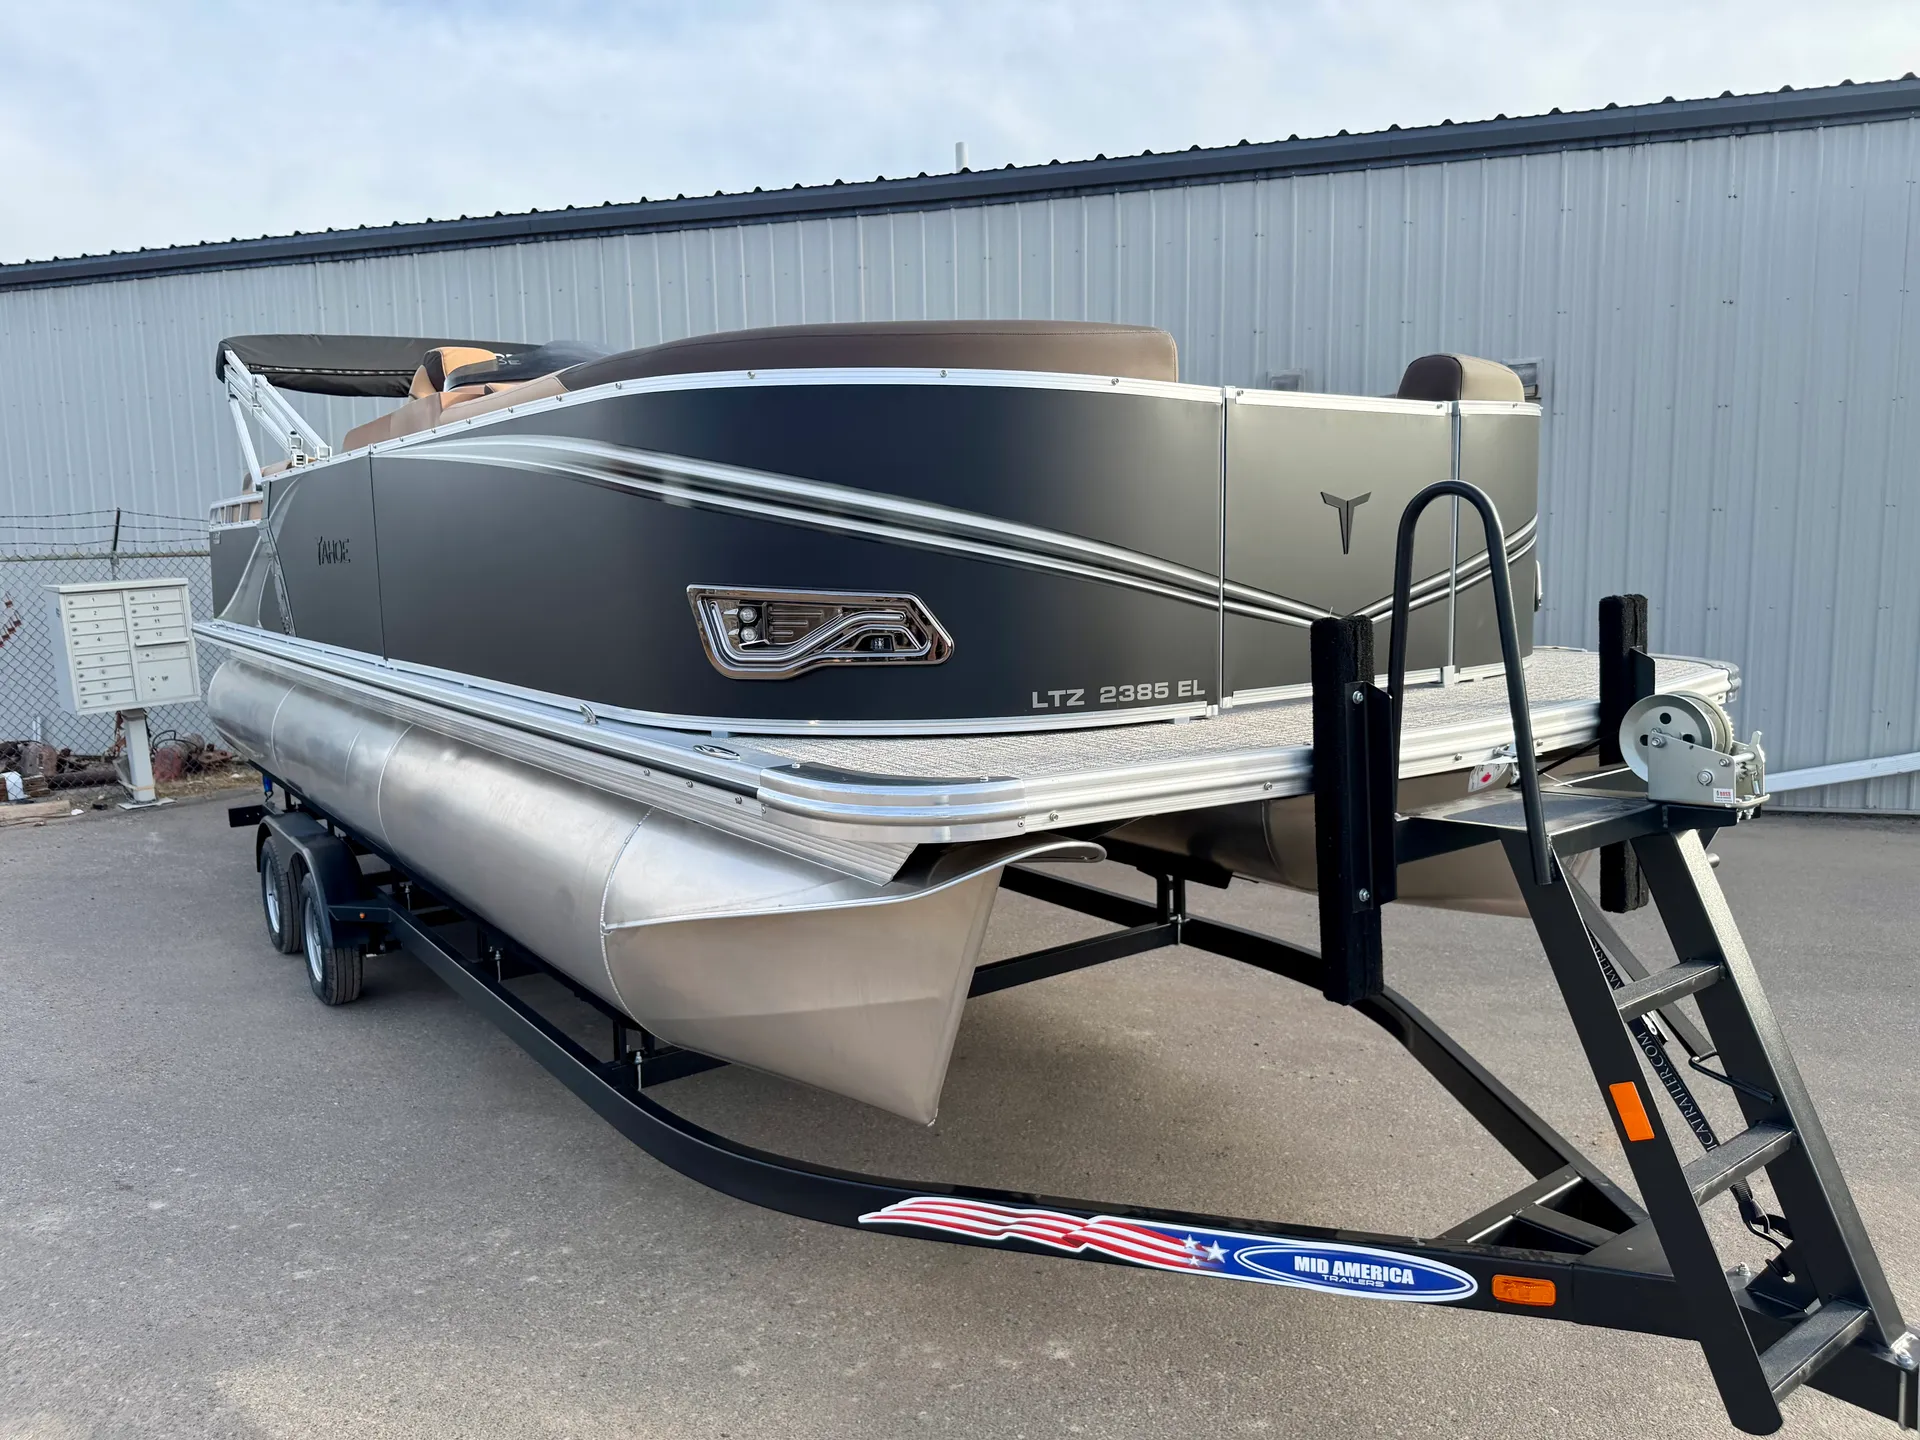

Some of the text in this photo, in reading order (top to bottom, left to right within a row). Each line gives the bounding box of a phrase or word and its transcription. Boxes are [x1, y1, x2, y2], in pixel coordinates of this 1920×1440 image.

[316, 535, 351, 566] TAHOE
[1032, 679, 1206, 708] LTZ 2385 EL
[1293, 1255, 1415, 1285] MID AMERICA
[1321, 1274, 1385, 1288] TRAILERS
